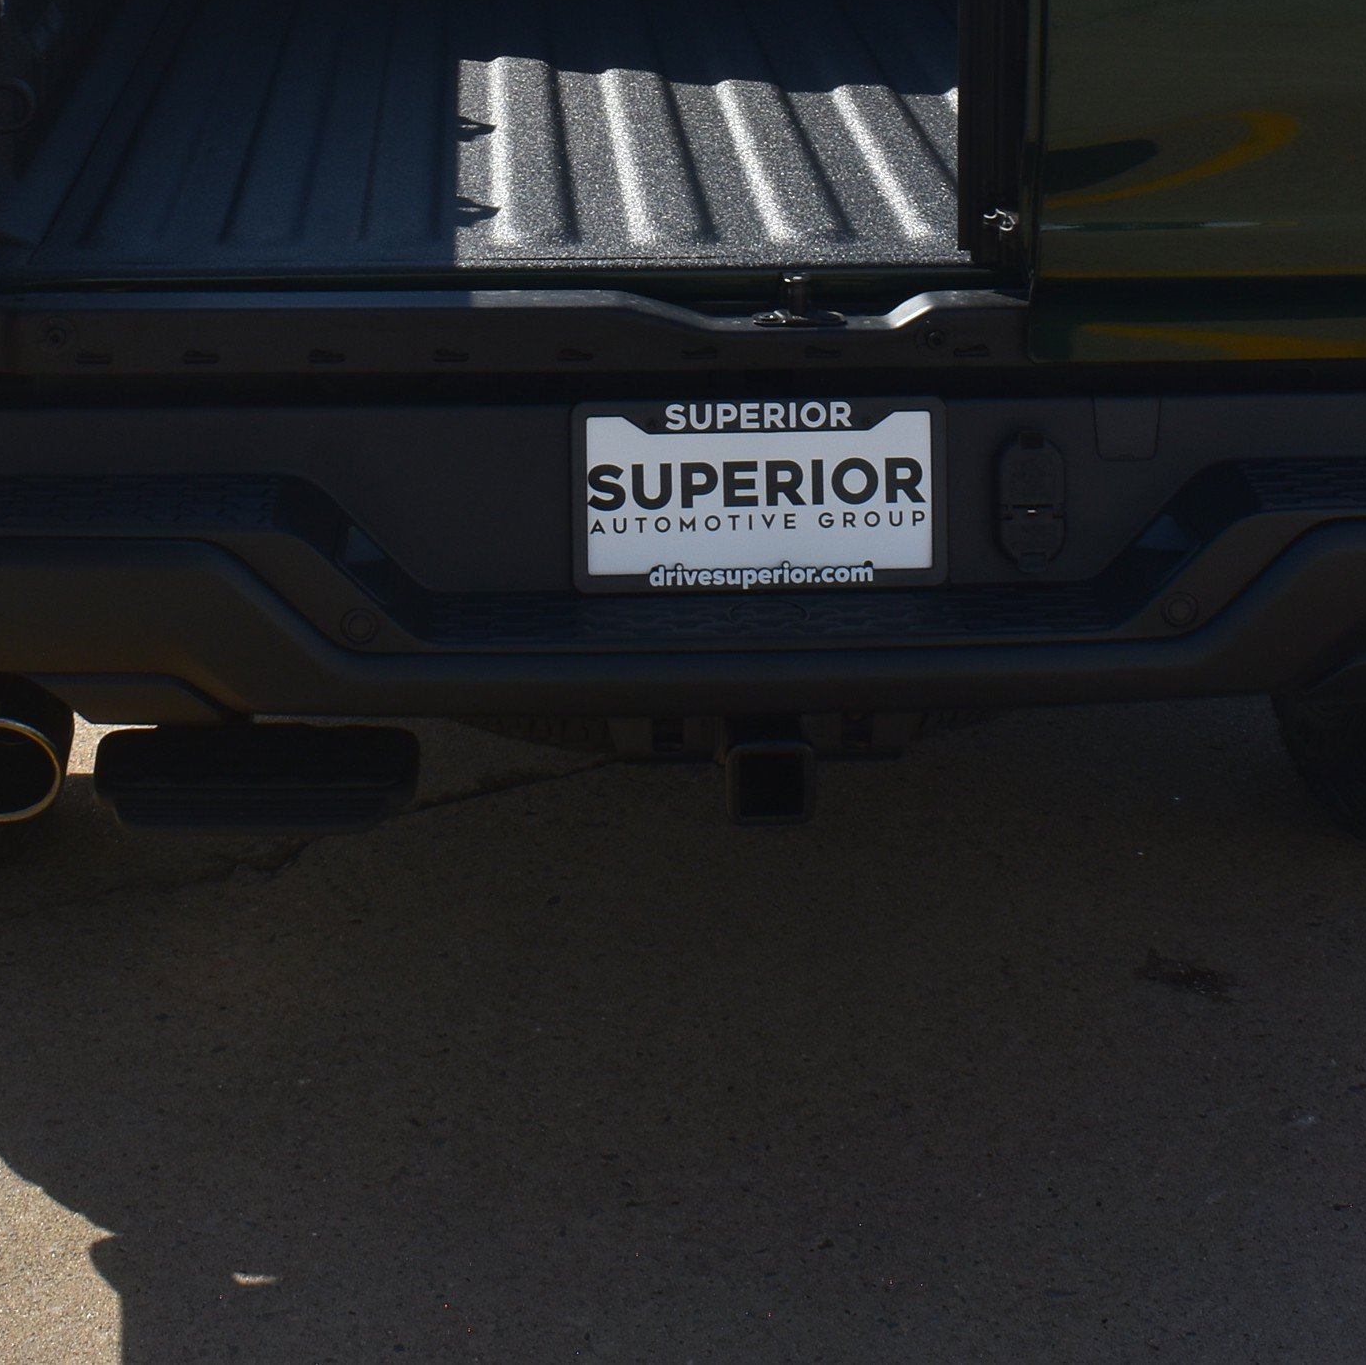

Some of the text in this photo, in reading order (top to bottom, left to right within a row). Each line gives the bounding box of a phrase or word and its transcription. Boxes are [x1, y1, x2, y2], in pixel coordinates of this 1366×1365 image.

[665, 401, 852, 431] SUPERIOR
[587, 457, 926, 511] SUPERIOR
[590, 510, 926, 535] AUTOMOTIVE GROUP
[649, 561, 874, 590] drivesuperior.com
